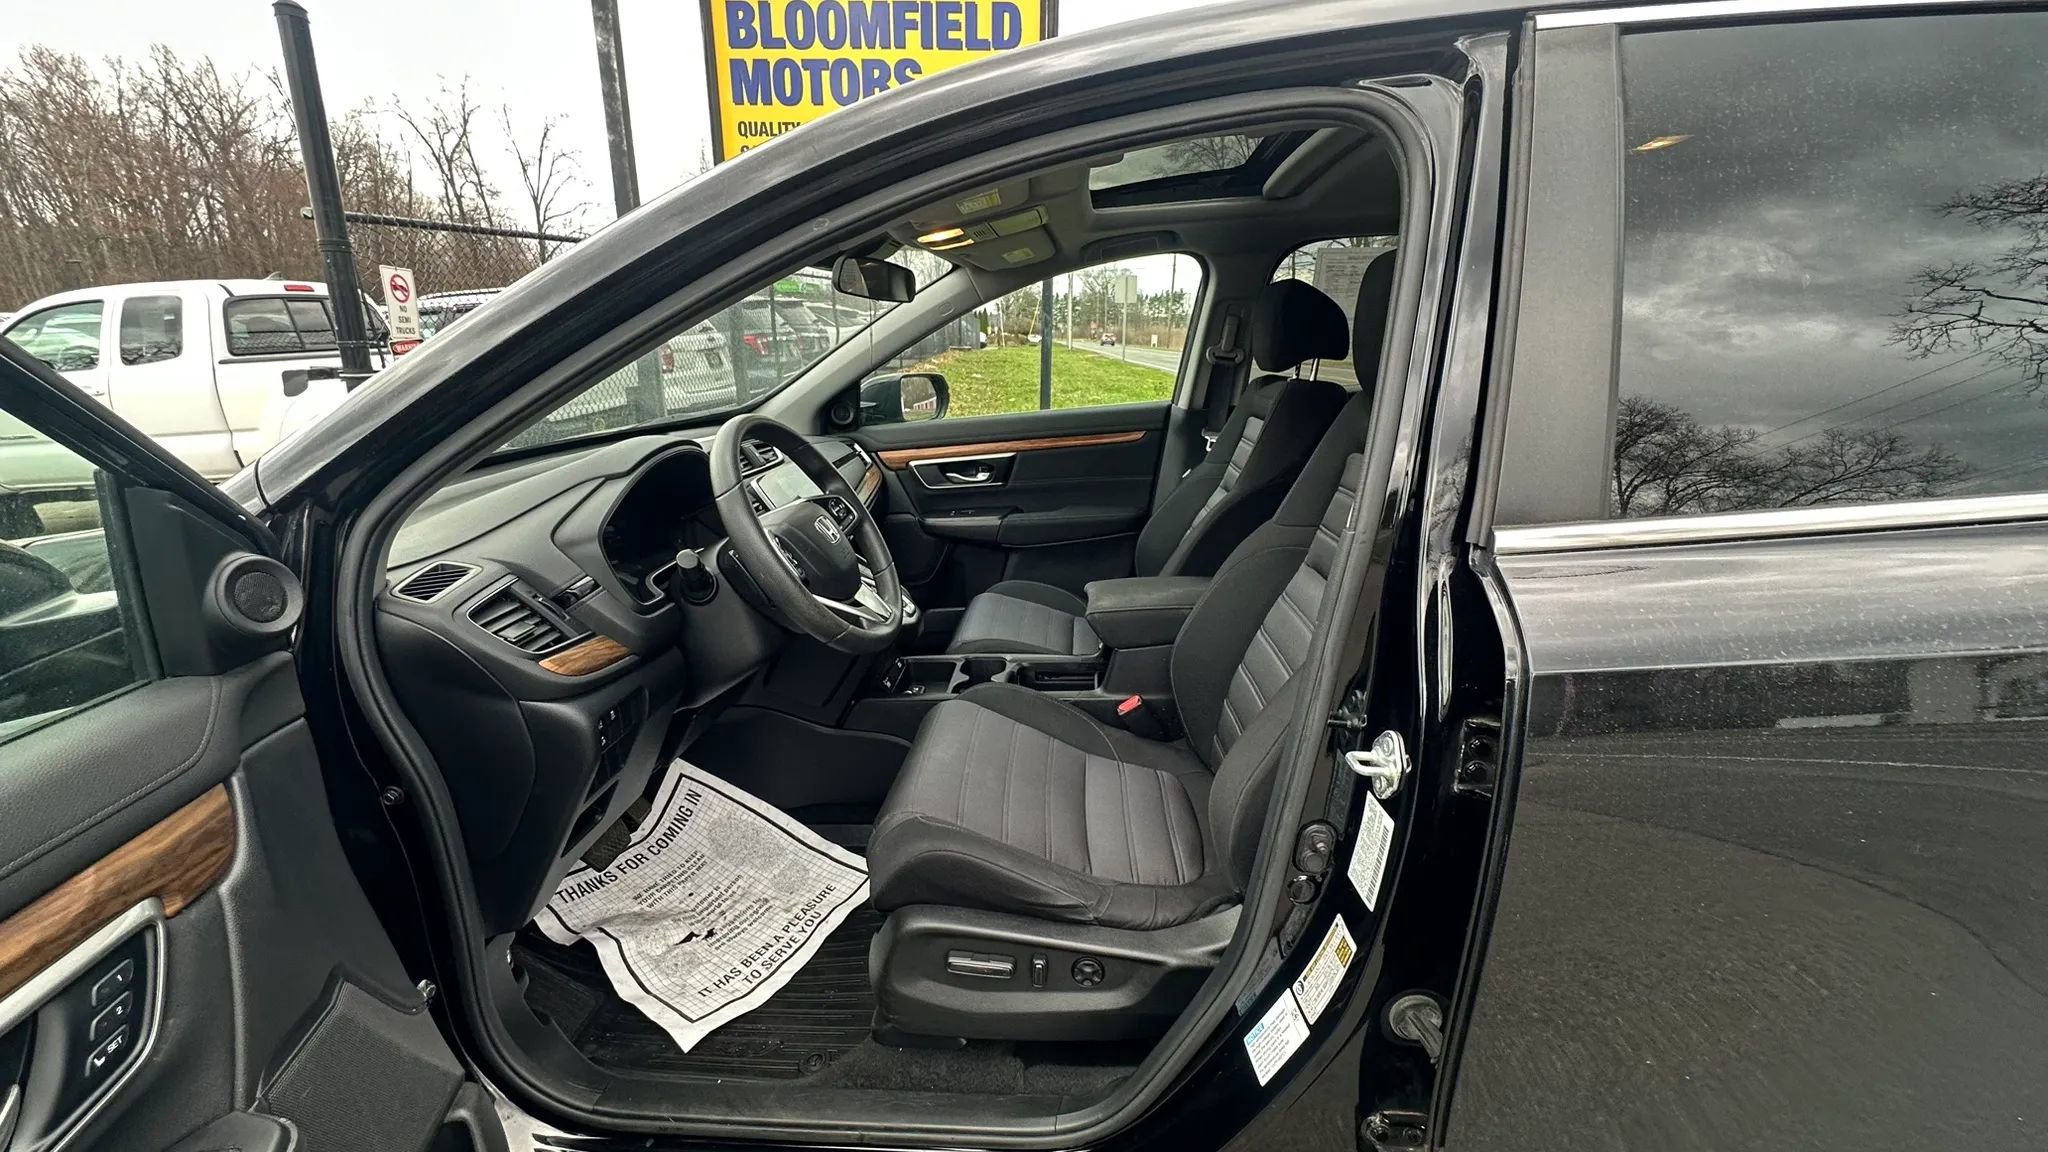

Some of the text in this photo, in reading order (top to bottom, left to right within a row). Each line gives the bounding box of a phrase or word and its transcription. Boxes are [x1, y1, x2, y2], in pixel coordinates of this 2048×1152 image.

[726, 0, 1022, 51] BLOOMFIELD
[399, 305, 407, 313] NO
[395, 326, 416, 335] TRUCKS
[555, 788, 702, 903] THANKS FOR COMING IN
[697, 883, 837, 997] IT HAS BEEN A PLEASURE
[742, 911, 822, 985] TO SERVE YOU
[116, 1006, 123, 1015] 2
[107, 1035, 122, 1053] SET
